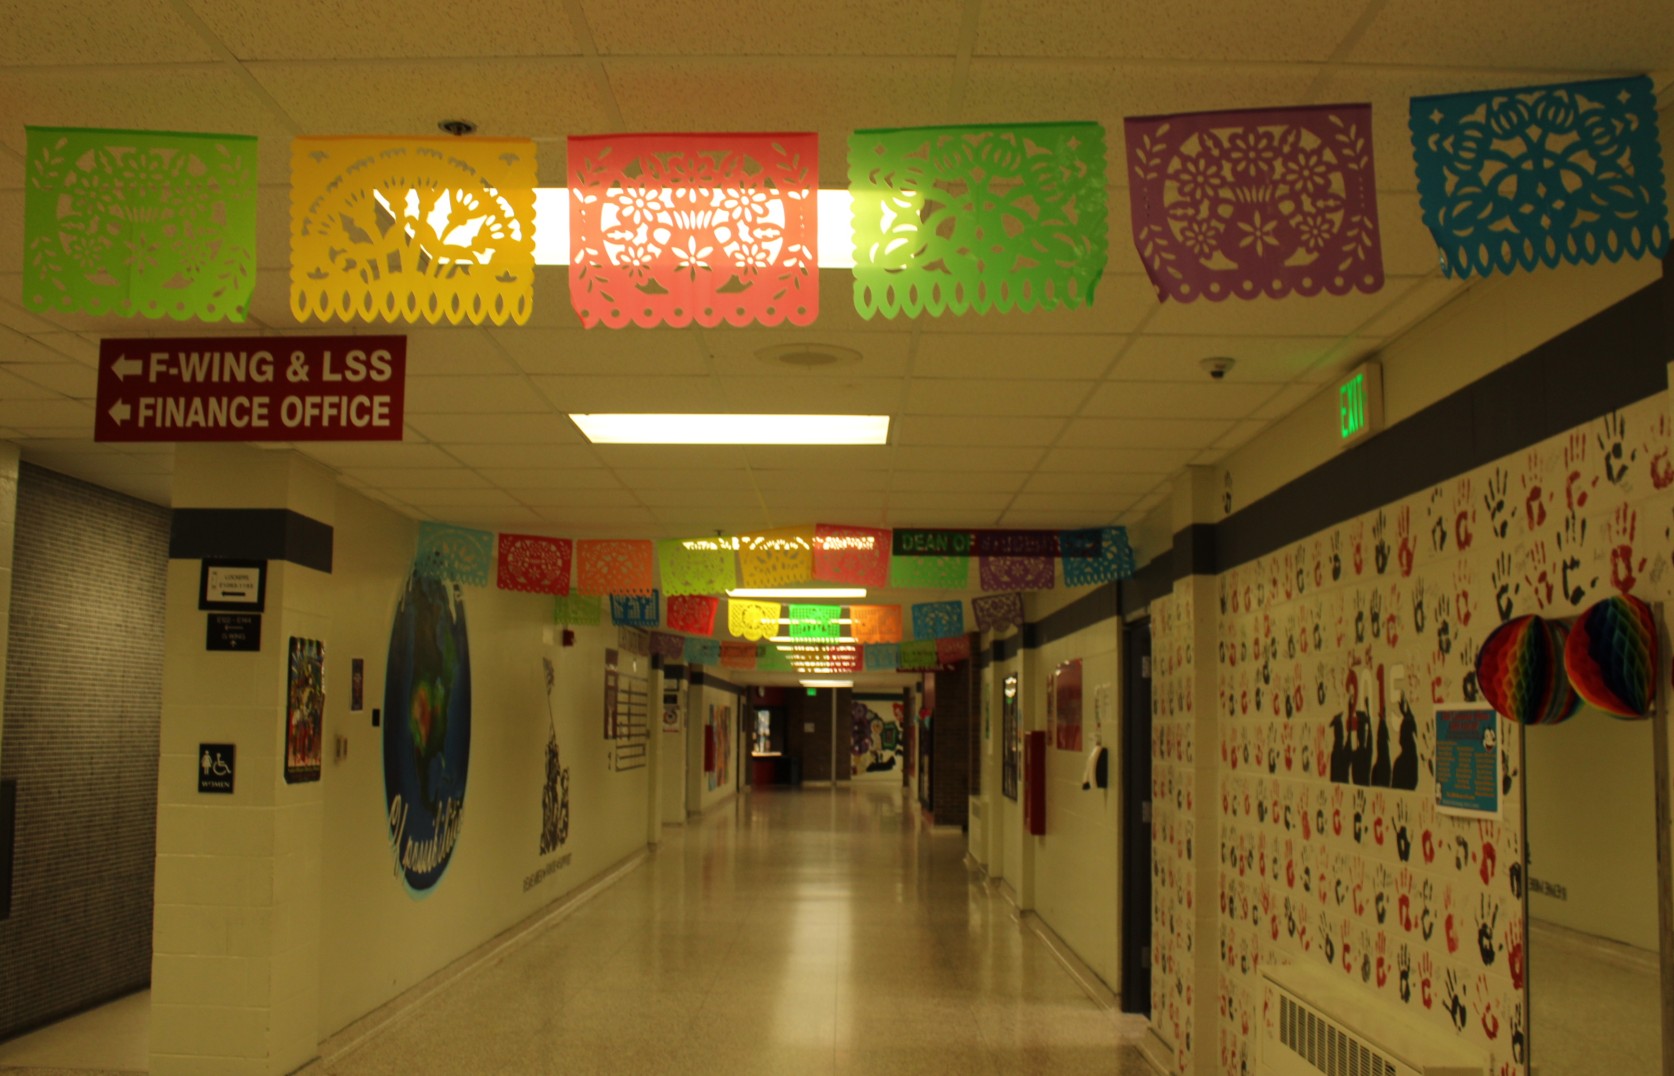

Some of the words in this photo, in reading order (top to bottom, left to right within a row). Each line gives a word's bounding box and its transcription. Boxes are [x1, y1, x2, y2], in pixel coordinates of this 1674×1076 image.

[148, 350, 274, 383] F-WING
[286, 350, 310, 383] &
[321, 349, 392, 382] LSS
[138, 395, 270, 428] FINANCE
[280, 394, 391, 428] OFFICE
[1341, 375, 1363, 437] EXIT
[901, 533, 948, 551] DEAN
[953, 533, 976, 551] OF
[1346, 663, 1405, 731] 2015
[201, 780, 231, 788] WOMEN
